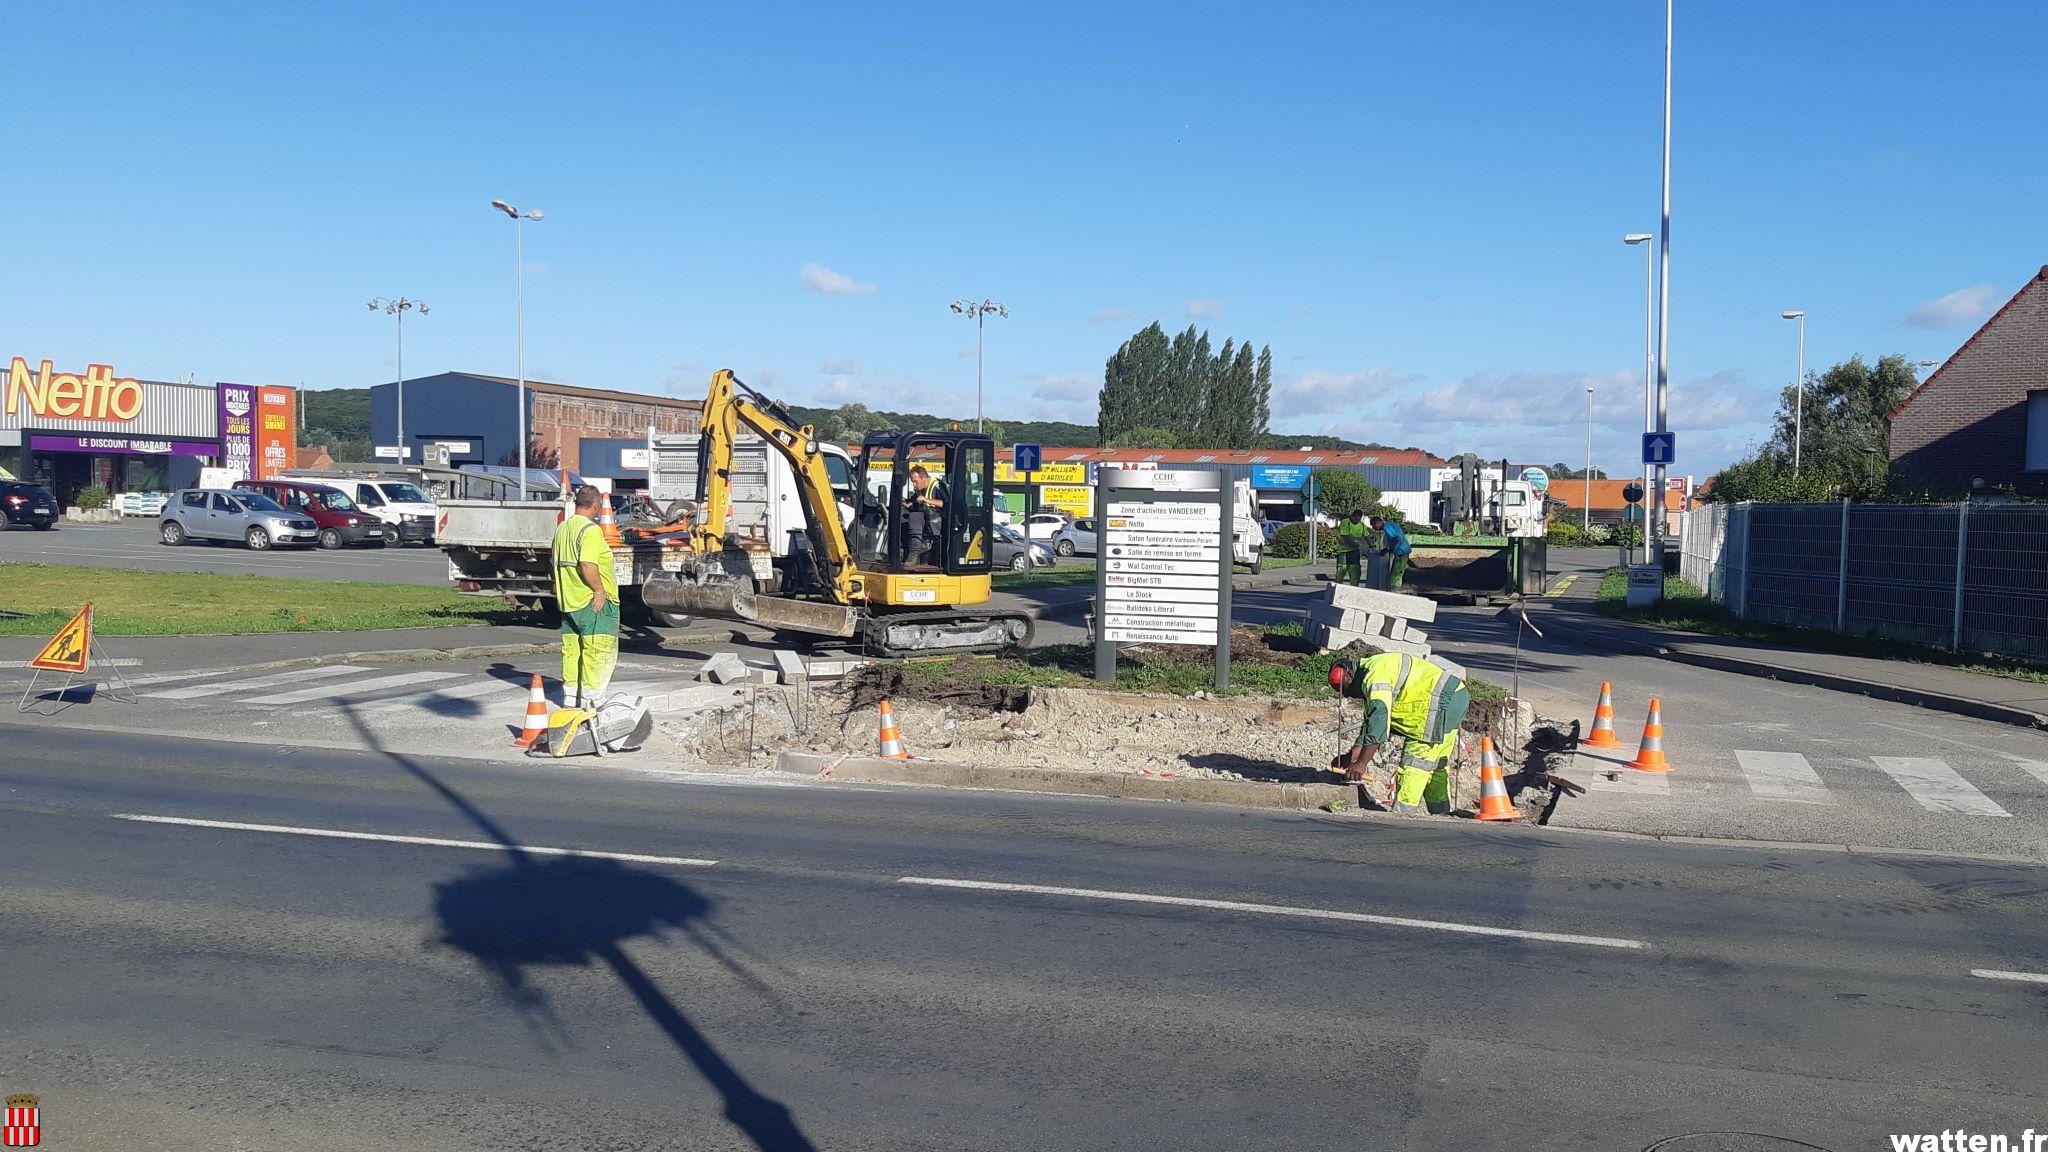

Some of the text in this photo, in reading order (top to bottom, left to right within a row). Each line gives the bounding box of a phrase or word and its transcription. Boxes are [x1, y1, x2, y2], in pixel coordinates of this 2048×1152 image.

[6, 358, 144, 420] Netto
[225, 389, 250, 403] PRIX
[226, 417, 250, 425] TOUS LES
[226, 425, 250, 434] JOURS
[226, 435, 241, 443] PLUS
[79, 438, 173, 450] LE DISCOUNT IMBATTABLE
[226, 443, 251, 456] 1000
[265, 447, 286, 458] OFFRES
[226, 460, 251, 473] PRIX
[1120, 506, 1135, 514] Zone
[1168, 507, 1207, 515] VANDESMET
[1146, 535, 1173, 543] funéraire
[1127, 548, 1143, 556] Salle
[1153, 549, 1174, 557] remise
[1164, 563, 1175, 571] Tec
[1127, 576, 1148, 585] BigMat
[1136, 591, 1153, 599] Stock
[1154, 605, 1175, 614] Littoral
[1126, 618, 1196, 628] Construction métallique
[1125, 632, 1163, 640] Renaissance
